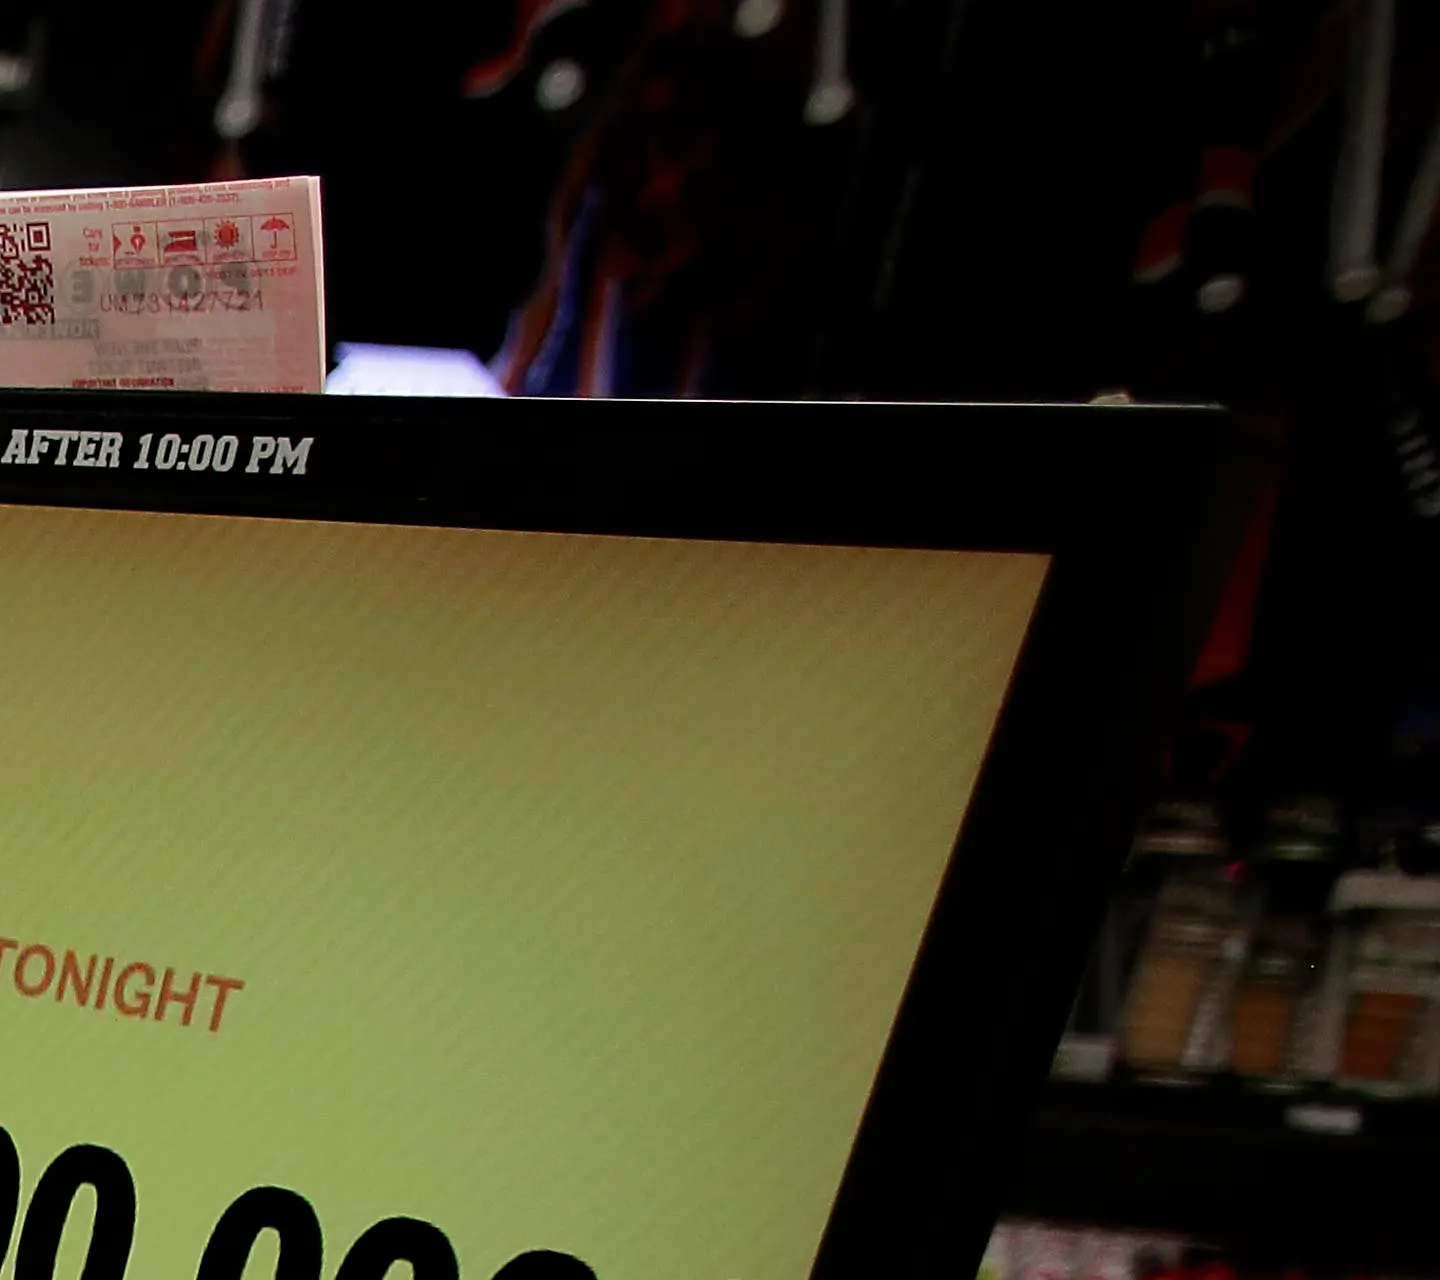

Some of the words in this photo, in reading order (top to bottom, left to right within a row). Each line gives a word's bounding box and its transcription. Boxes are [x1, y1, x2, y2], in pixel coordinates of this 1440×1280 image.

[2, 428, 121, 469] AFTER
[133, 432, 237, 473] 10:00
[245, 435, 314, 476] PM
